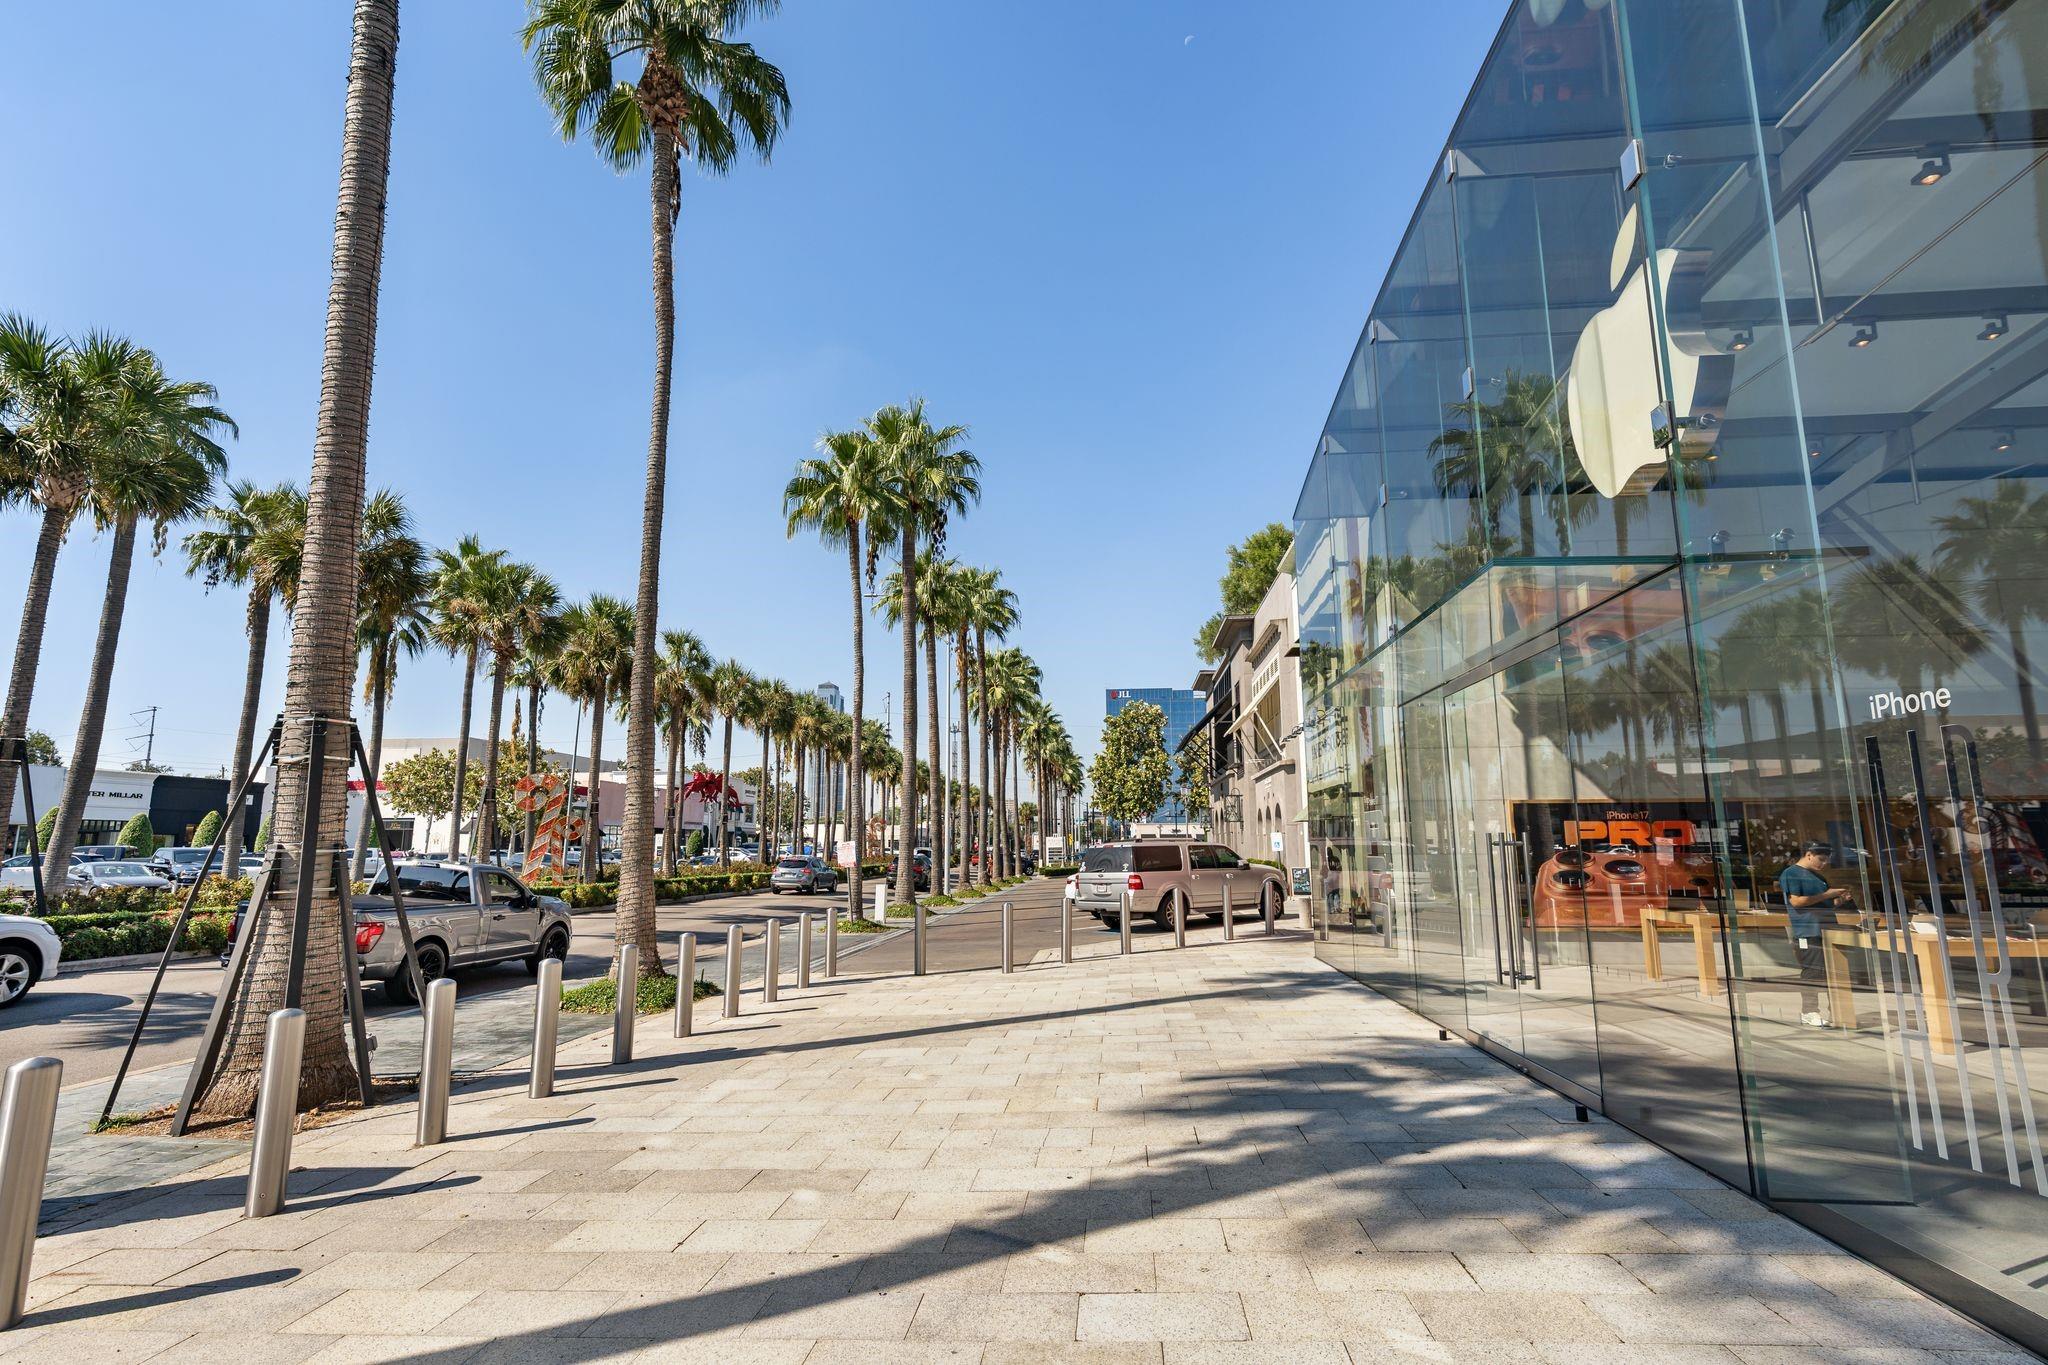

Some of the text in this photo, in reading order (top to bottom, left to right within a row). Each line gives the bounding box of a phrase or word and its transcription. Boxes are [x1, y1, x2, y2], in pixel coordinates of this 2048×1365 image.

[1118, 690, 1132, 698] JLL
[1869, 687, 1952, 720] iPhone
[109, 791, 144, 799] MILLAR
[1606, 810, 1649, 820] iPhone 17
[1563, 820, 1697, 847] PRO
